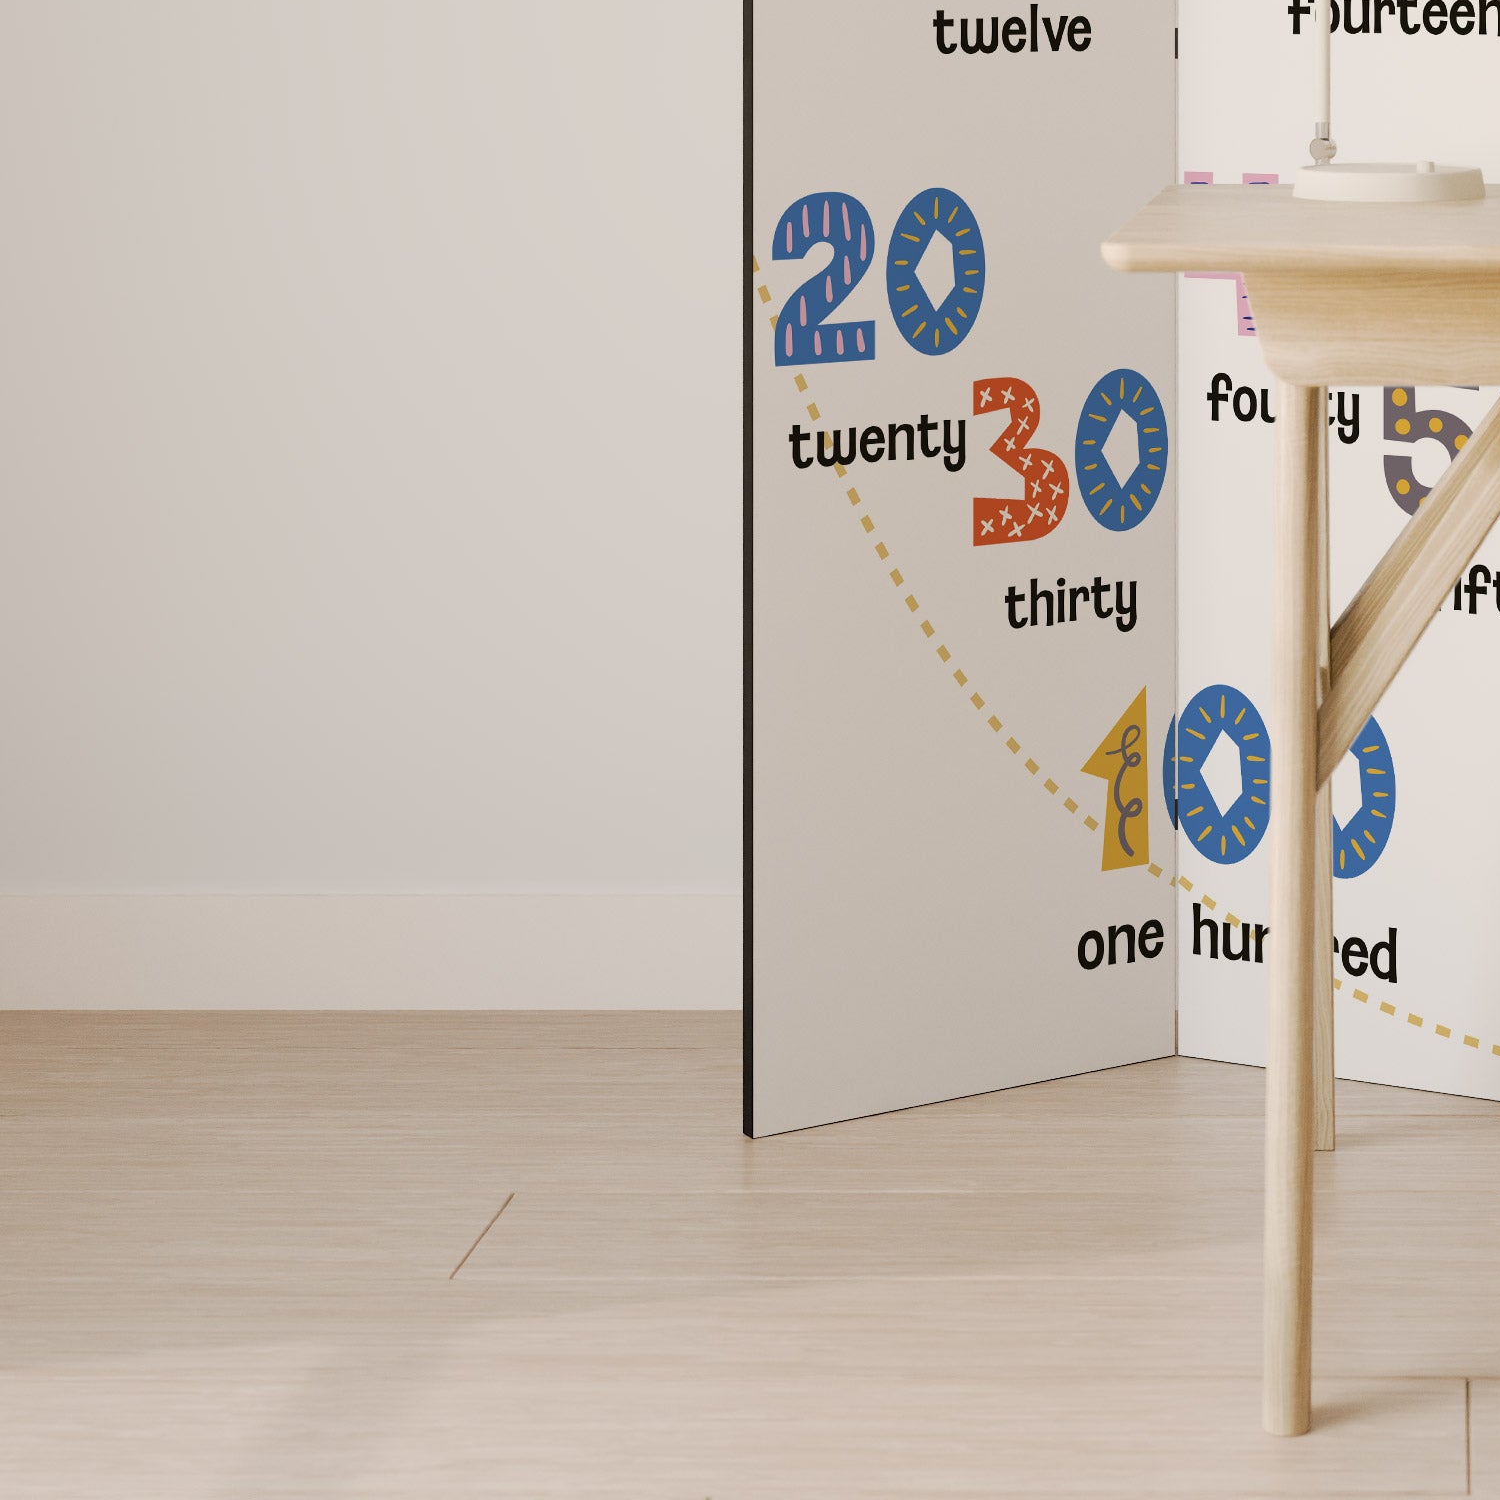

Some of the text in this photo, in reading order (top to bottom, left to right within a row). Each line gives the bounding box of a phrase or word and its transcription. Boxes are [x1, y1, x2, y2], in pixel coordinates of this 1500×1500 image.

[933, 4, 1091, 54] twelve
[772, 187, 985, 367] 20
[789, 415, 965, 472] twenty
[973, 368, 1168, 547] 30
[1005, 577, 1138, 632] thirty
[1078, 920, 1164, 970] one
